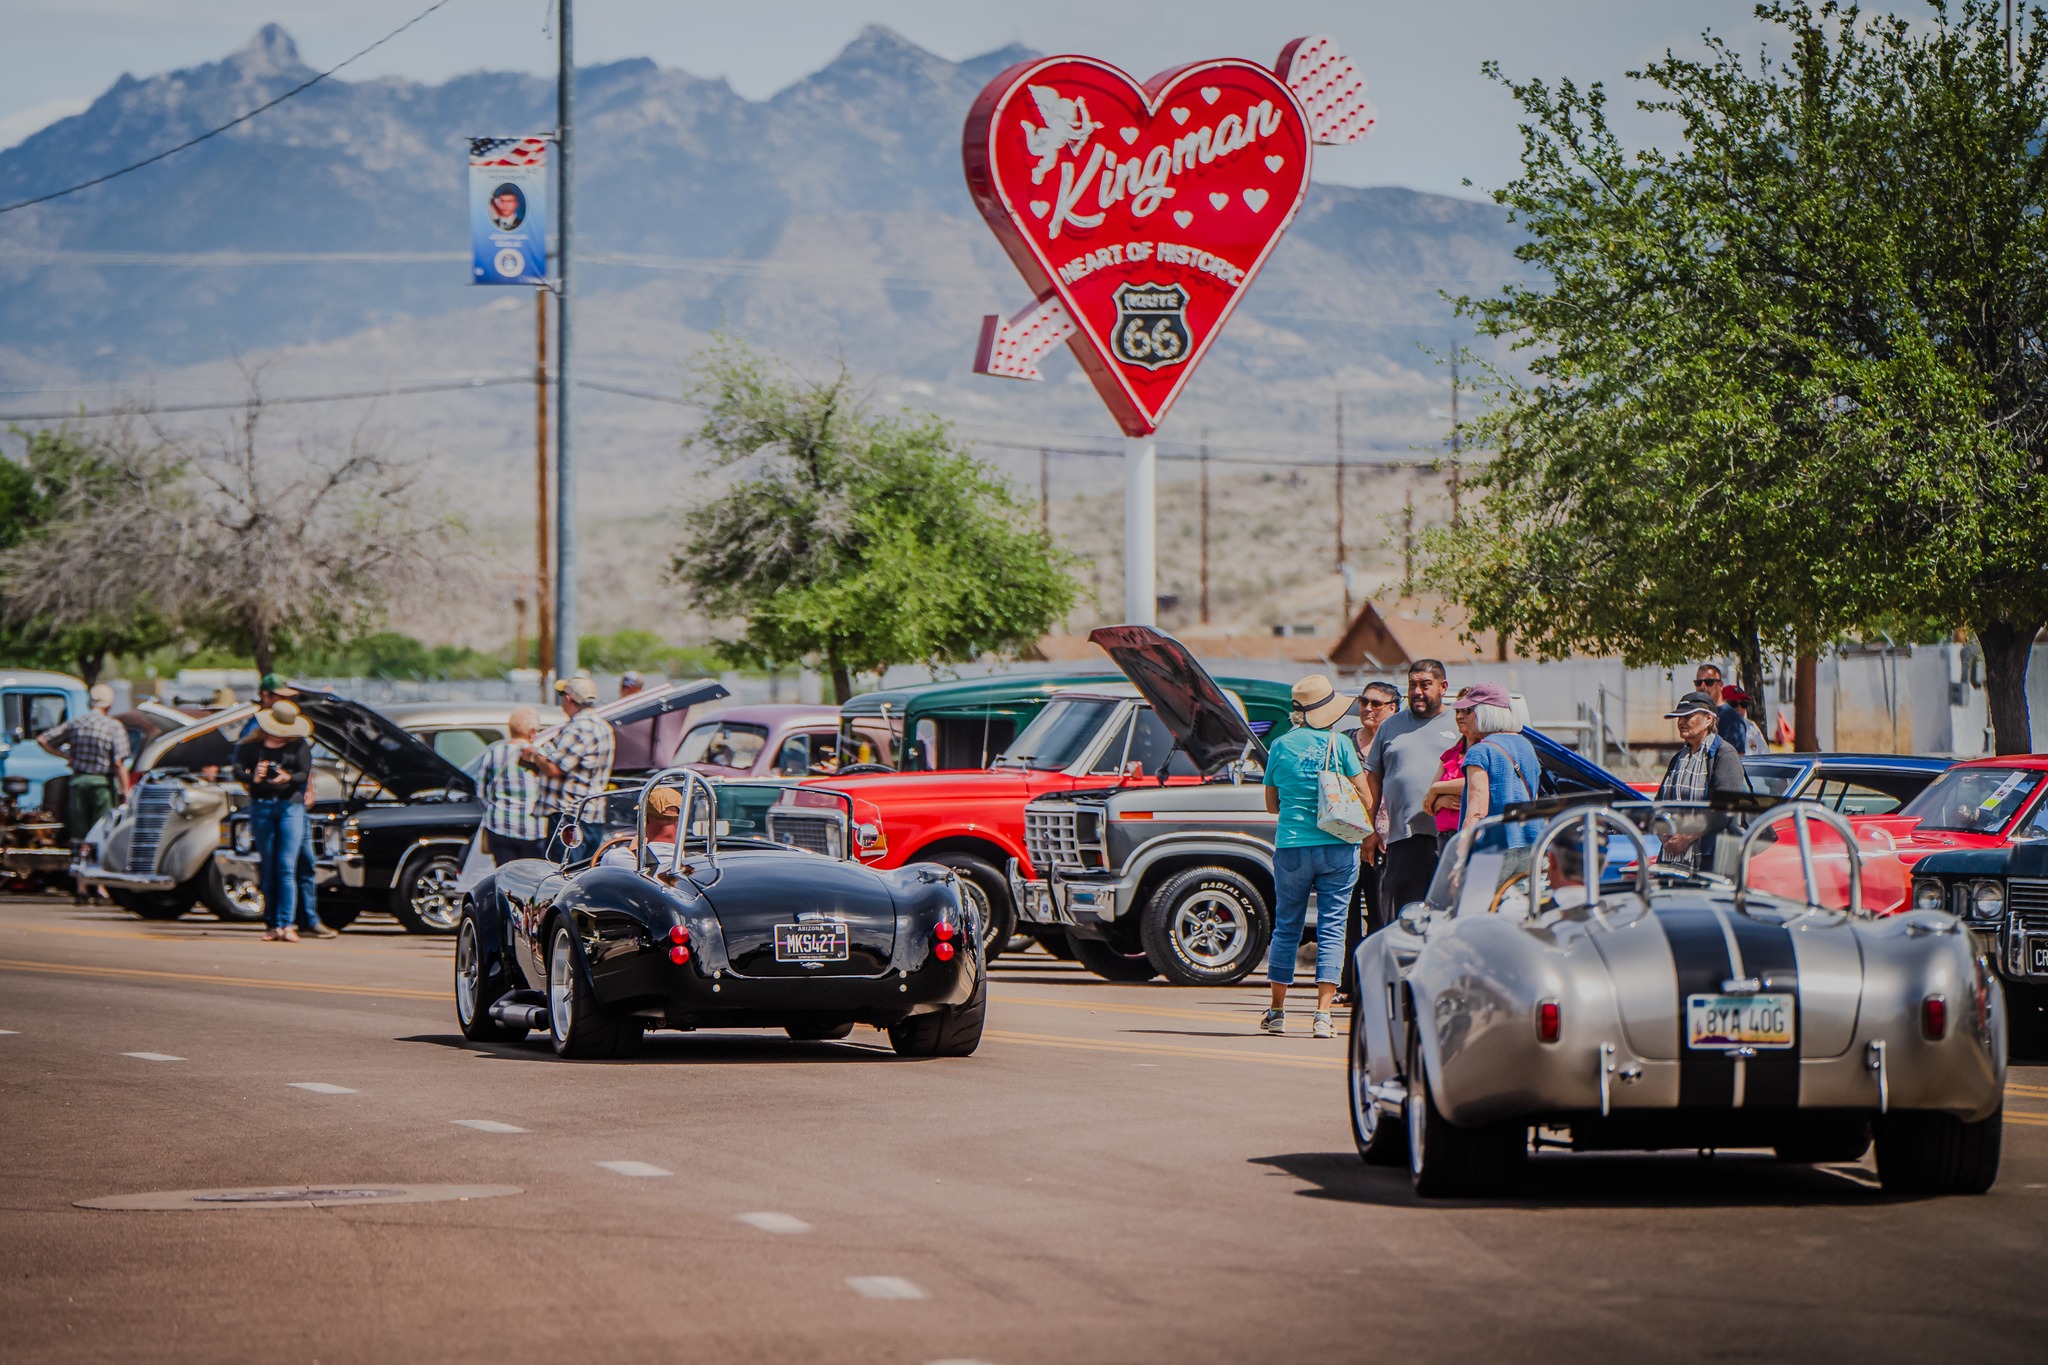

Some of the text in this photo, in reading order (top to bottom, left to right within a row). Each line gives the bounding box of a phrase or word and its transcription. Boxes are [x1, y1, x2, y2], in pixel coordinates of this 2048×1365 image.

[1049, 100, 1283, 240] Kingman
[1058, 241, 1245, 287] HEART OF HISTORIC
[1123, 292, 1180, 309] ROUTE
[1123, 317, 1182, 359] 66
[1200, 881, 1240, 898] RADIAL
[786, 933, 837, 953] MKS427
